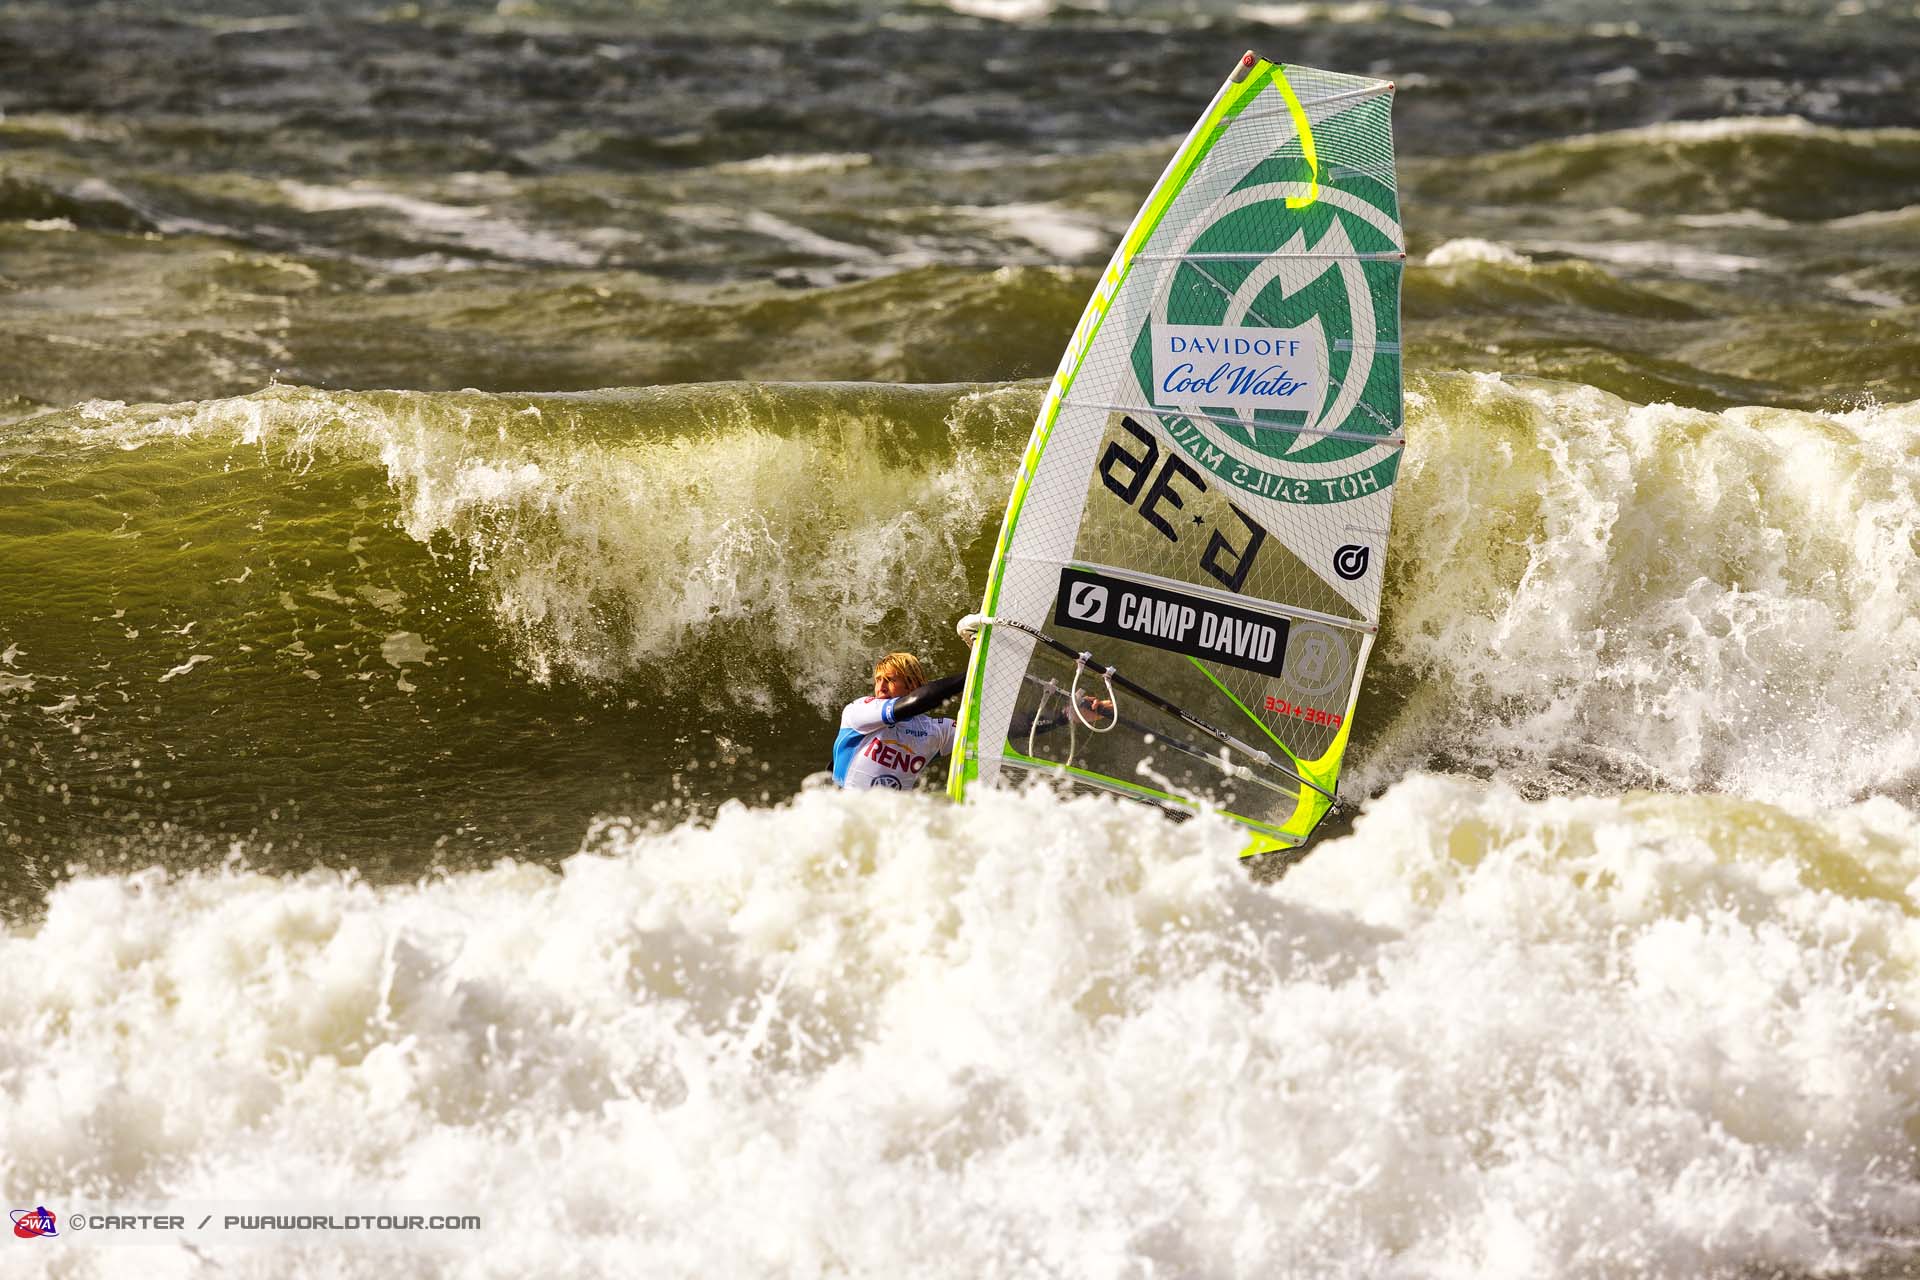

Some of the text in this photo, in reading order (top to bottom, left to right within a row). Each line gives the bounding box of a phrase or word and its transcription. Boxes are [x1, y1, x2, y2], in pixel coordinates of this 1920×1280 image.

[1170, 336, 1301, 357] DAVIDOFF
[1163, 362, 1308, 397] Cool Water
[1117, 592, 1277, 664] CAMP DAVID
[863, 737, 927, 775] RENO
